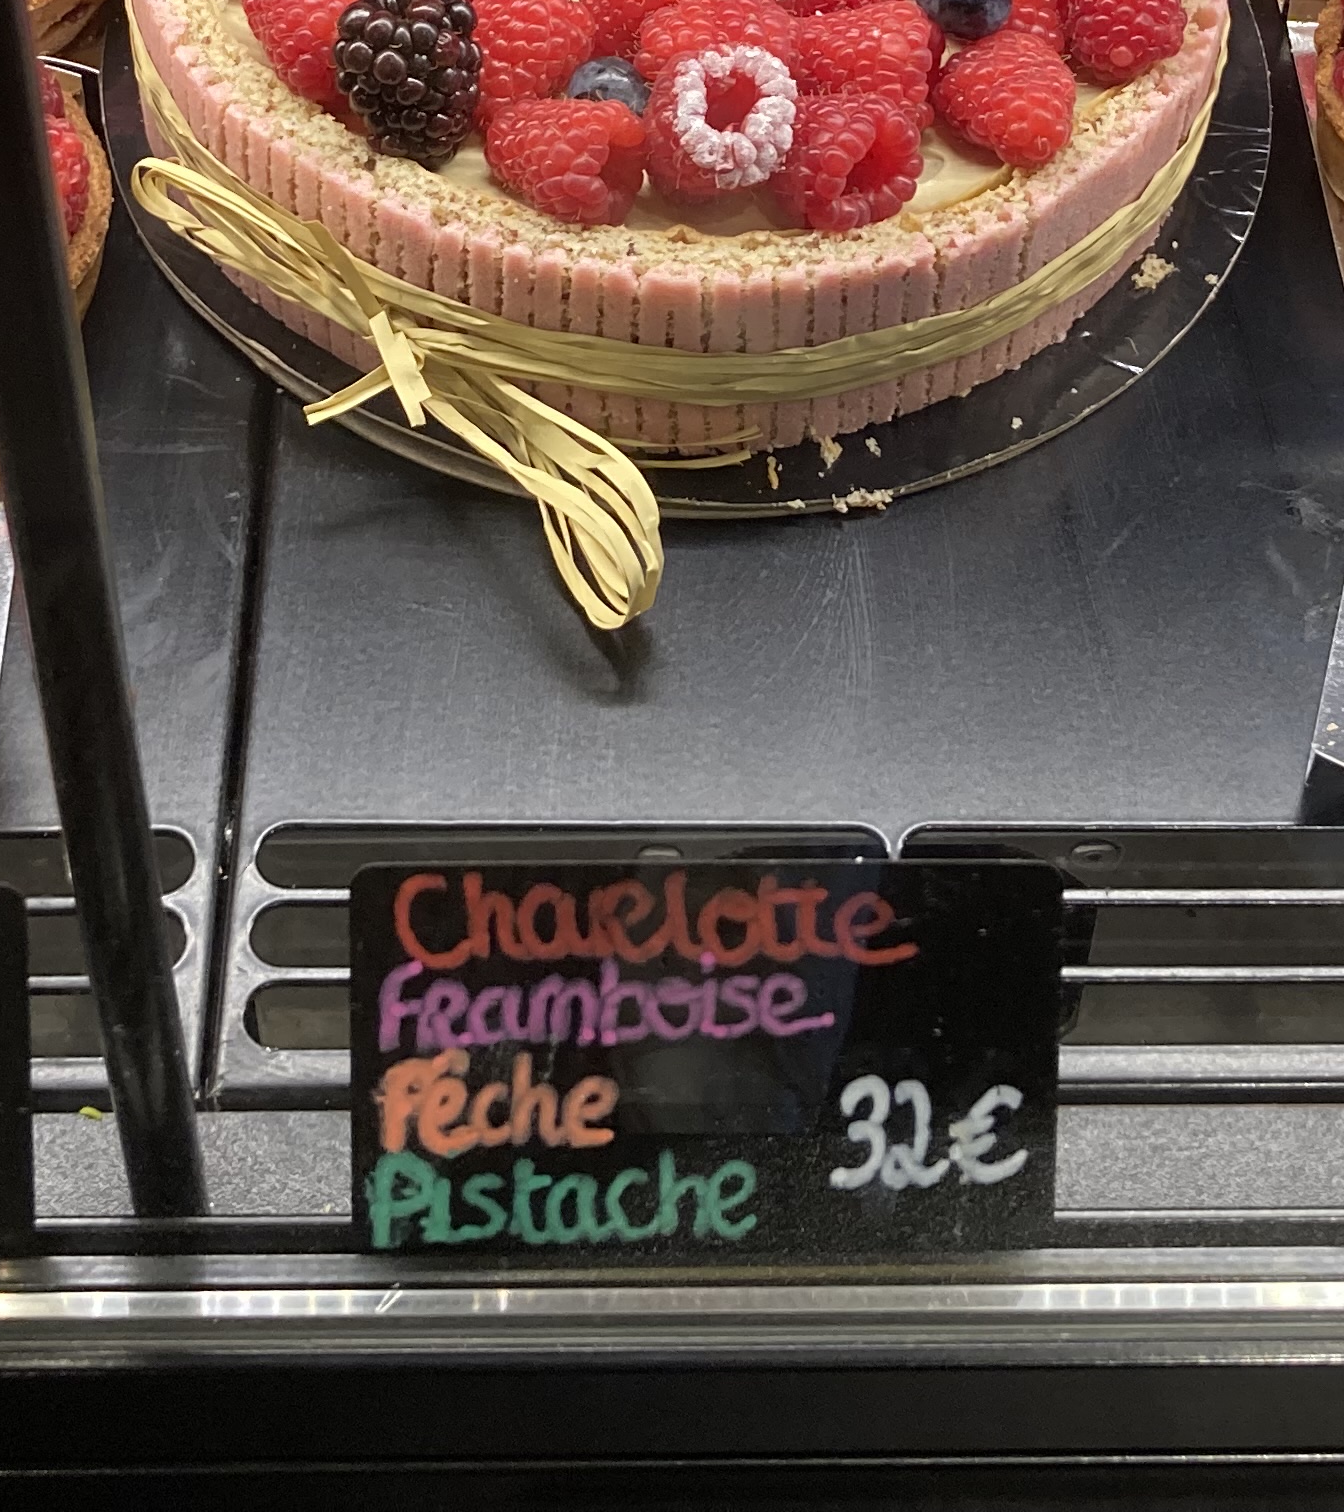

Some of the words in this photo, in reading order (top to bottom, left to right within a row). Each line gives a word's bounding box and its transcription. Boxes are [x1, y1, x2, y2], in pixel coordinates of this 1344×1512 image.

[393, 870, 920, 969] Charlotte
[378, 951, 835, 1051] Framboise
[374, 1049, 619, 1156] Pêche
[829, 1074, 1029, 1190] 32€
[365, 1149, 757, 1249] Pistache
